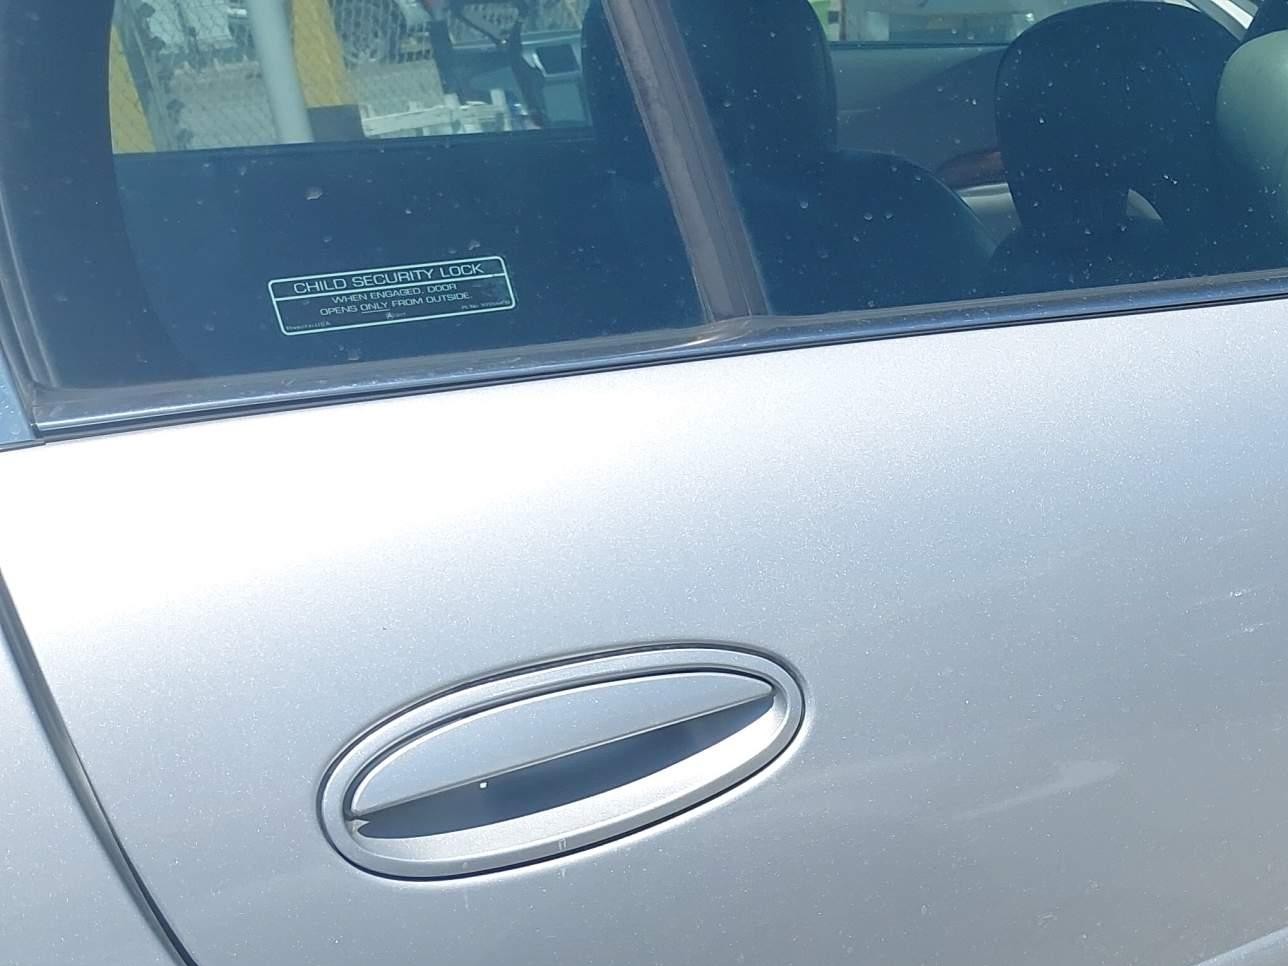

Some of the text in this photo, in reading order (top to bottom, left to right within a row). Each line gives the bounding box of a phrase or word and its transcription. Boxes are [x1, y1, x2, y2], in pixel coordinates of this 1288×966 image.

[293, 263, 485, 295] CHILD SECURITY LOCK
[331, 293, 368, 304] WHEN
[427, 283, 457, 294] DOOR
[319, 305, 358, 316] OPENS
[360, 301, 390, 314] ONLY
[391, 297, 424, 308] FROM
